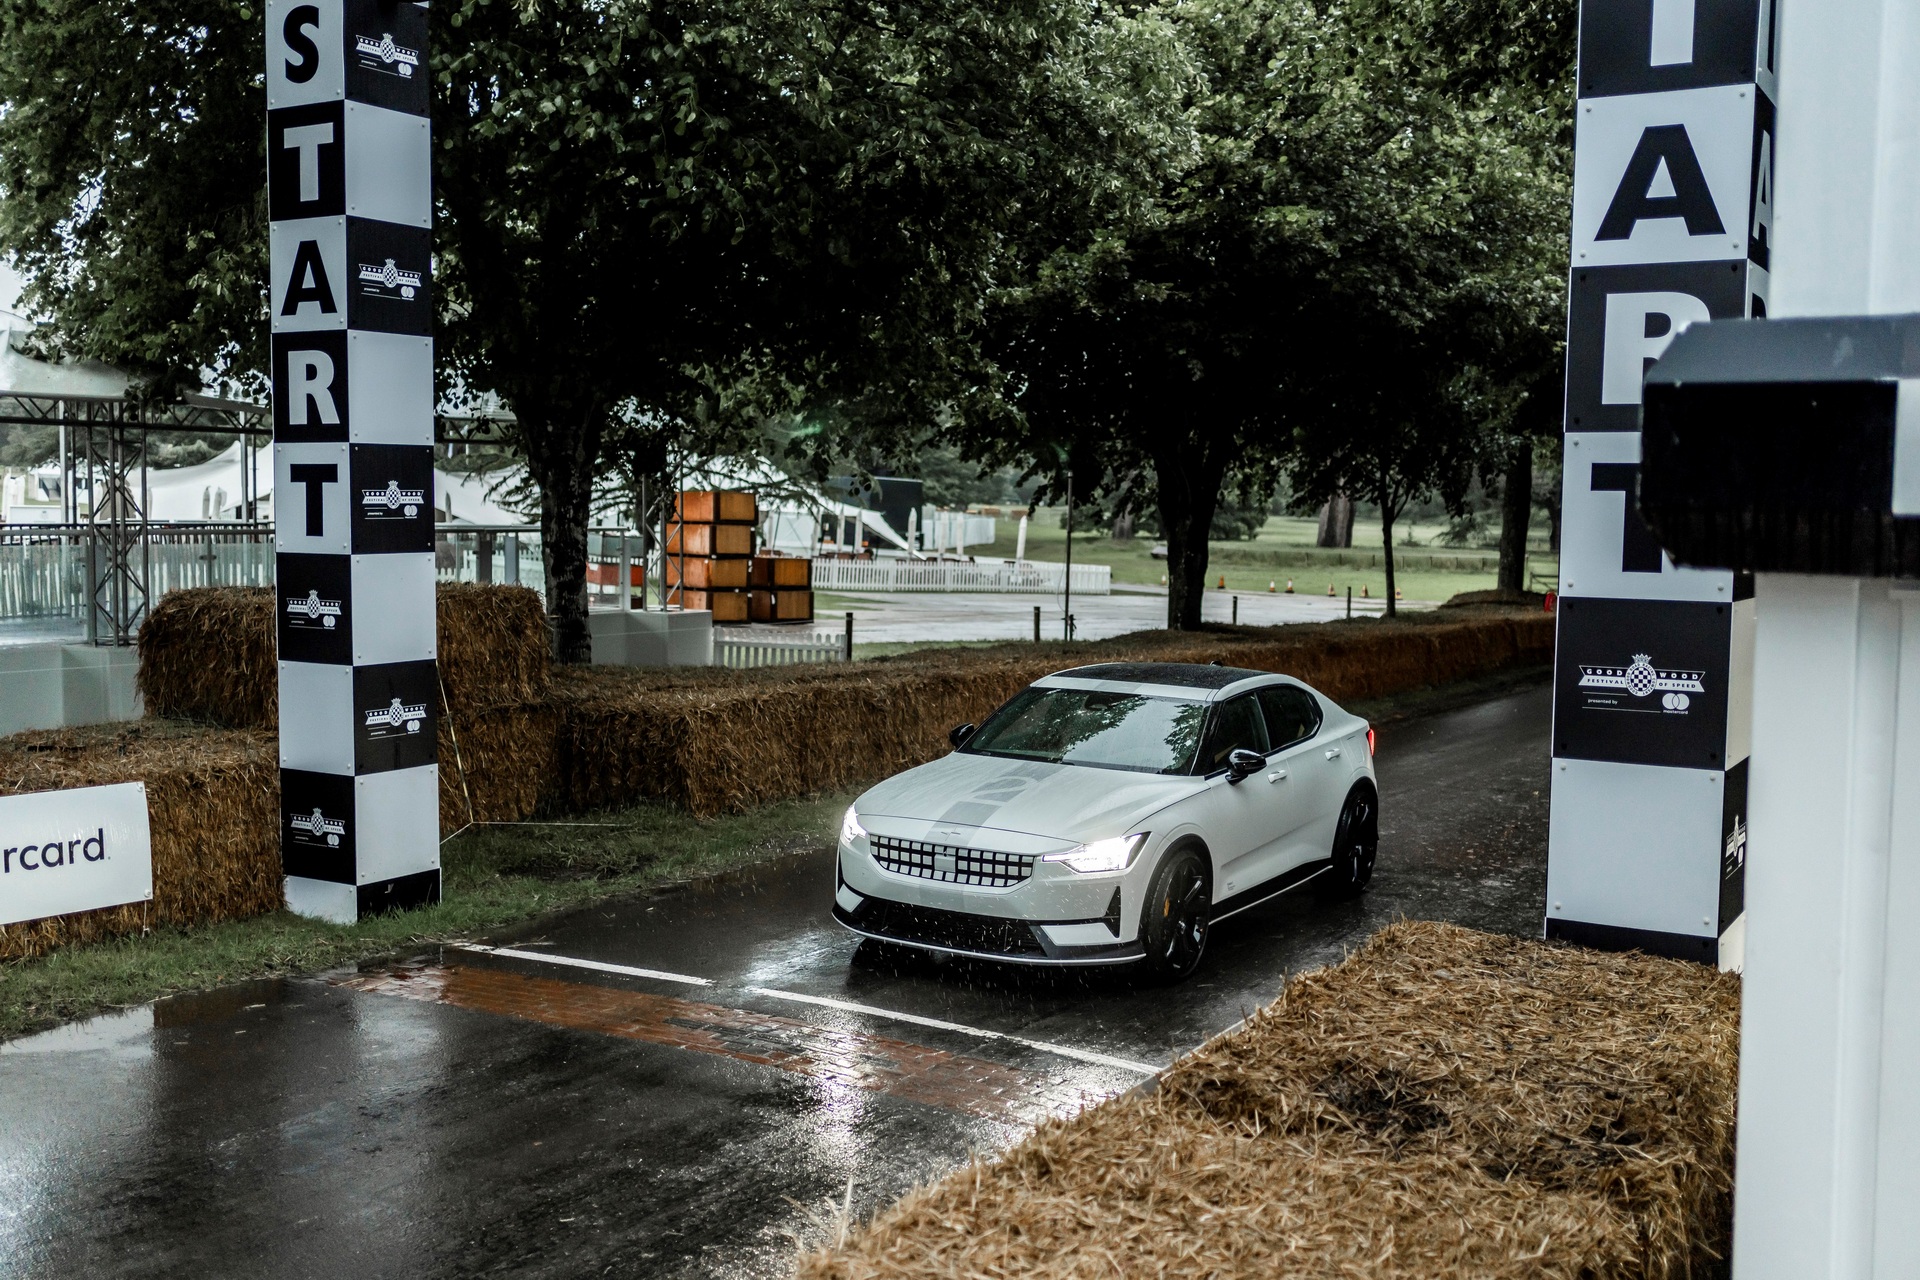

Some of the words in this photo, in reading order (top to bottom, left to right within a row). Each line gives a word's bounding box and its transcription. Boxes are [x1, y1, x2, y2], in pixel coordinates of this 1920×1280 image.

[282, 5, 341, 537] START
[1586, 668, 1623, 676] GOOD
[1659, 672, 1698, 680] WOOD
